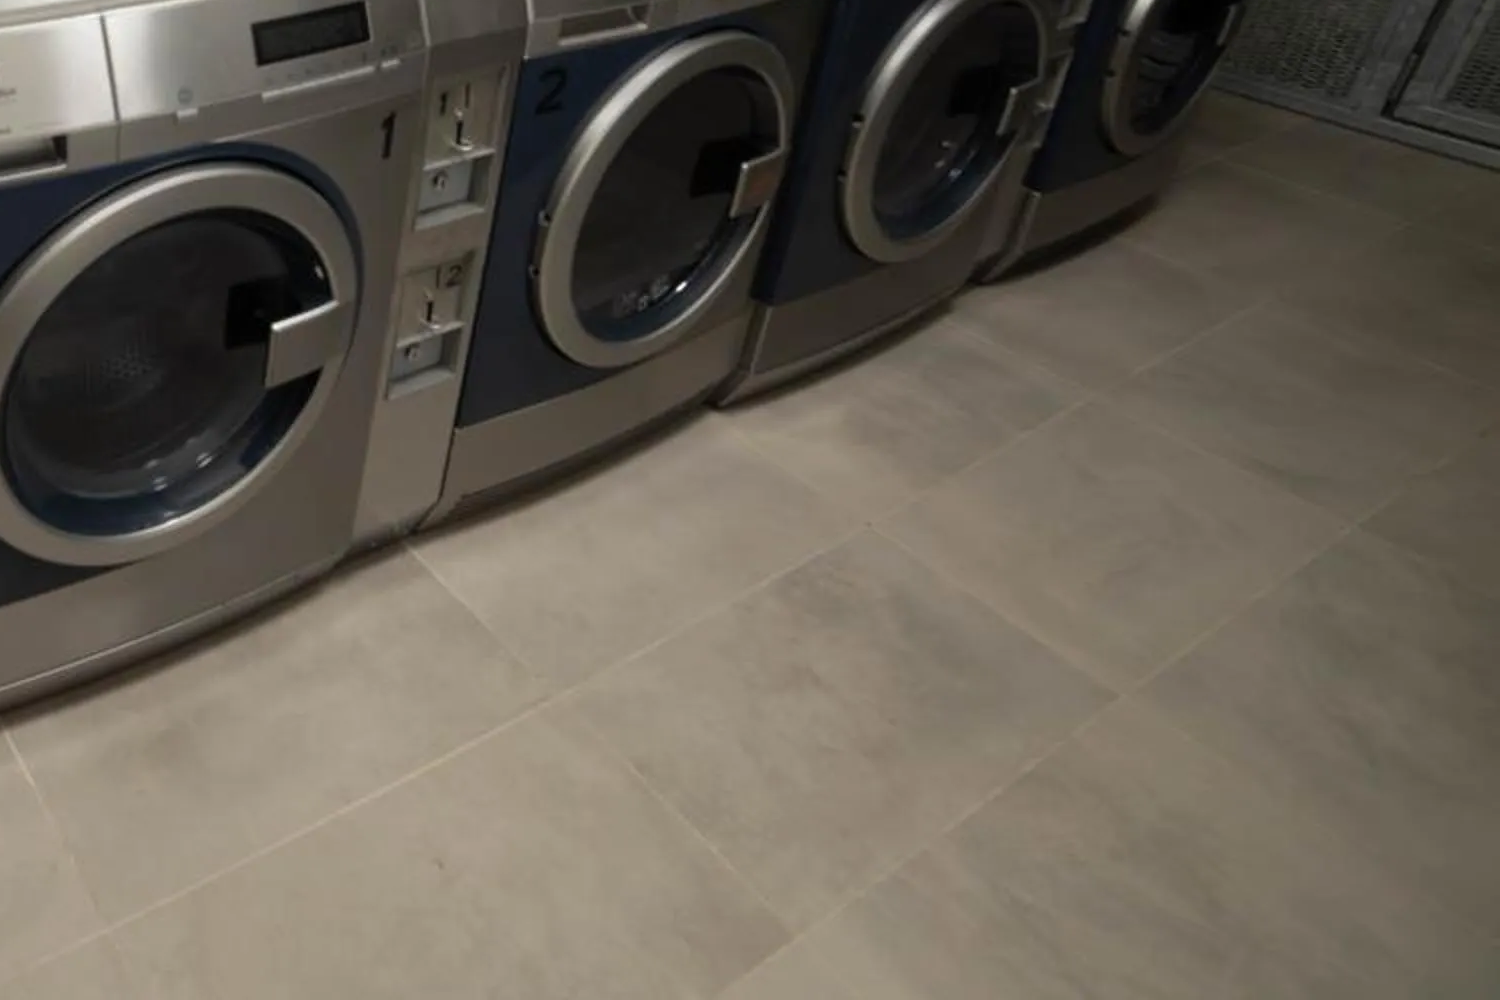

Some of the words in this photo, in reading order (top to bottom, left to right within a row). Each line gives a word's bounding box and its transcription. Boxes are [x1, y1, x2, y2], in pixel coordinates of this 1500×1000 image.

[534, 66, 569, 115] 2
[380, 110, 397, 160] 1
[445, 264, 463, 289] 2
